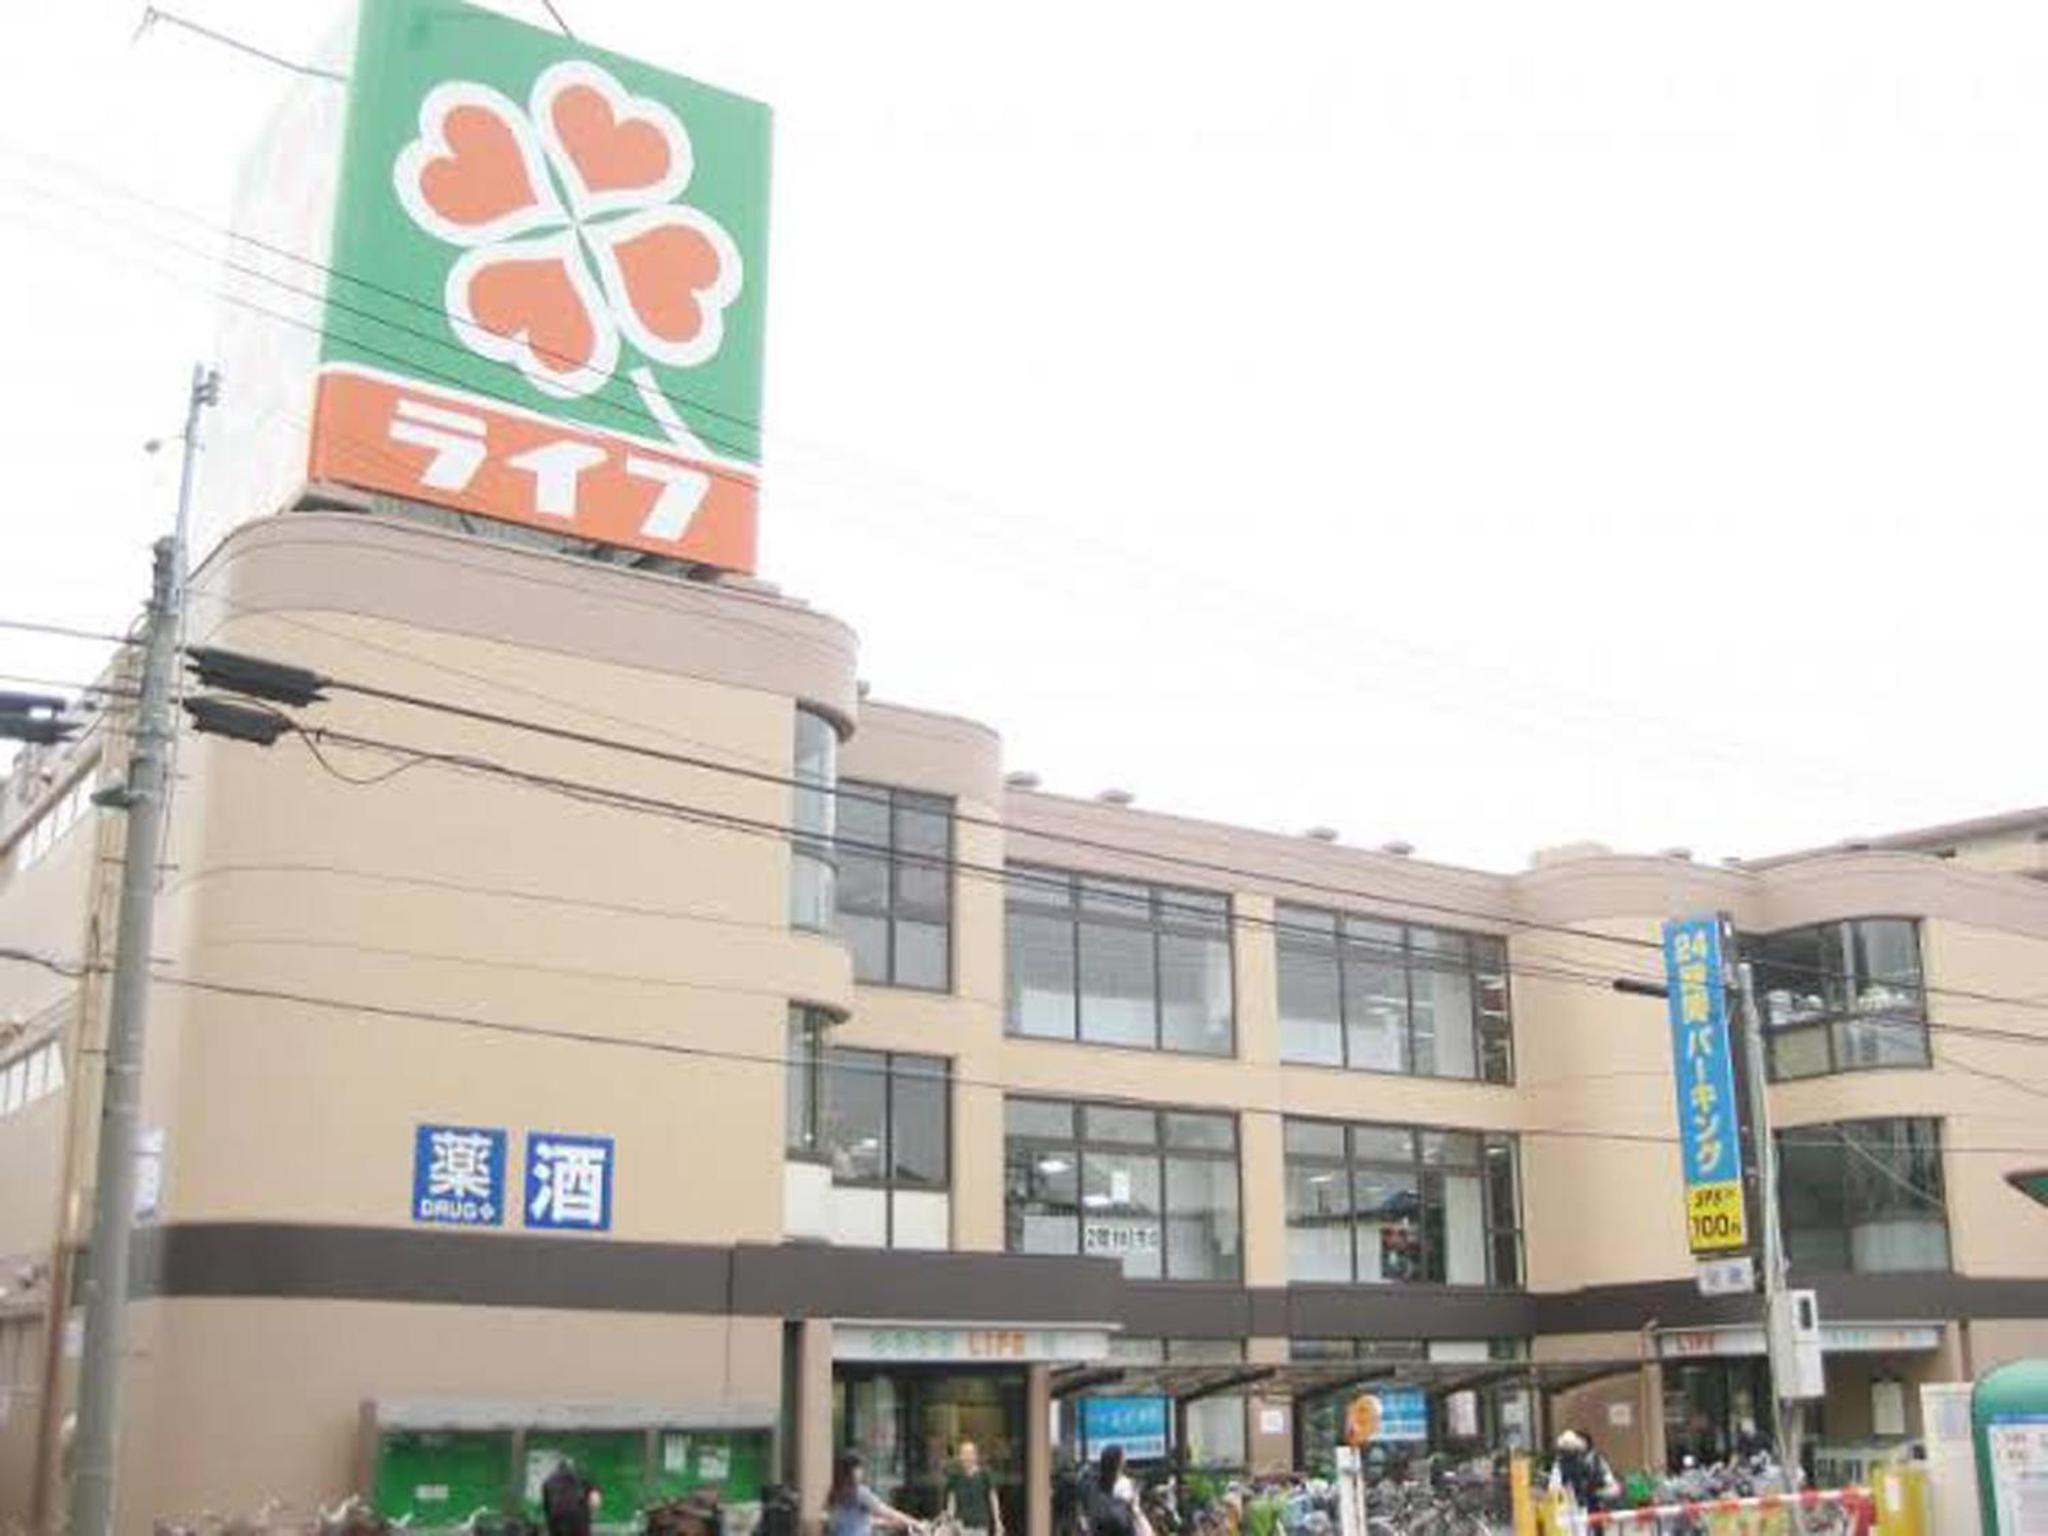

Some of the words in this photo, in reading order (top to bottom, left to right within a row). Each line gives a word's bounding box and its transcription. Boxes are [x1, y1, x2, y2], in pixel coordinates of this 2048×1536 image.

[389, 399, 711, 543] ライフ
[429, 1131, 493, 1199] 薬
[529, 1141, 607, 1225] 酒
[419, 1197, 479, 1221] DRUG
